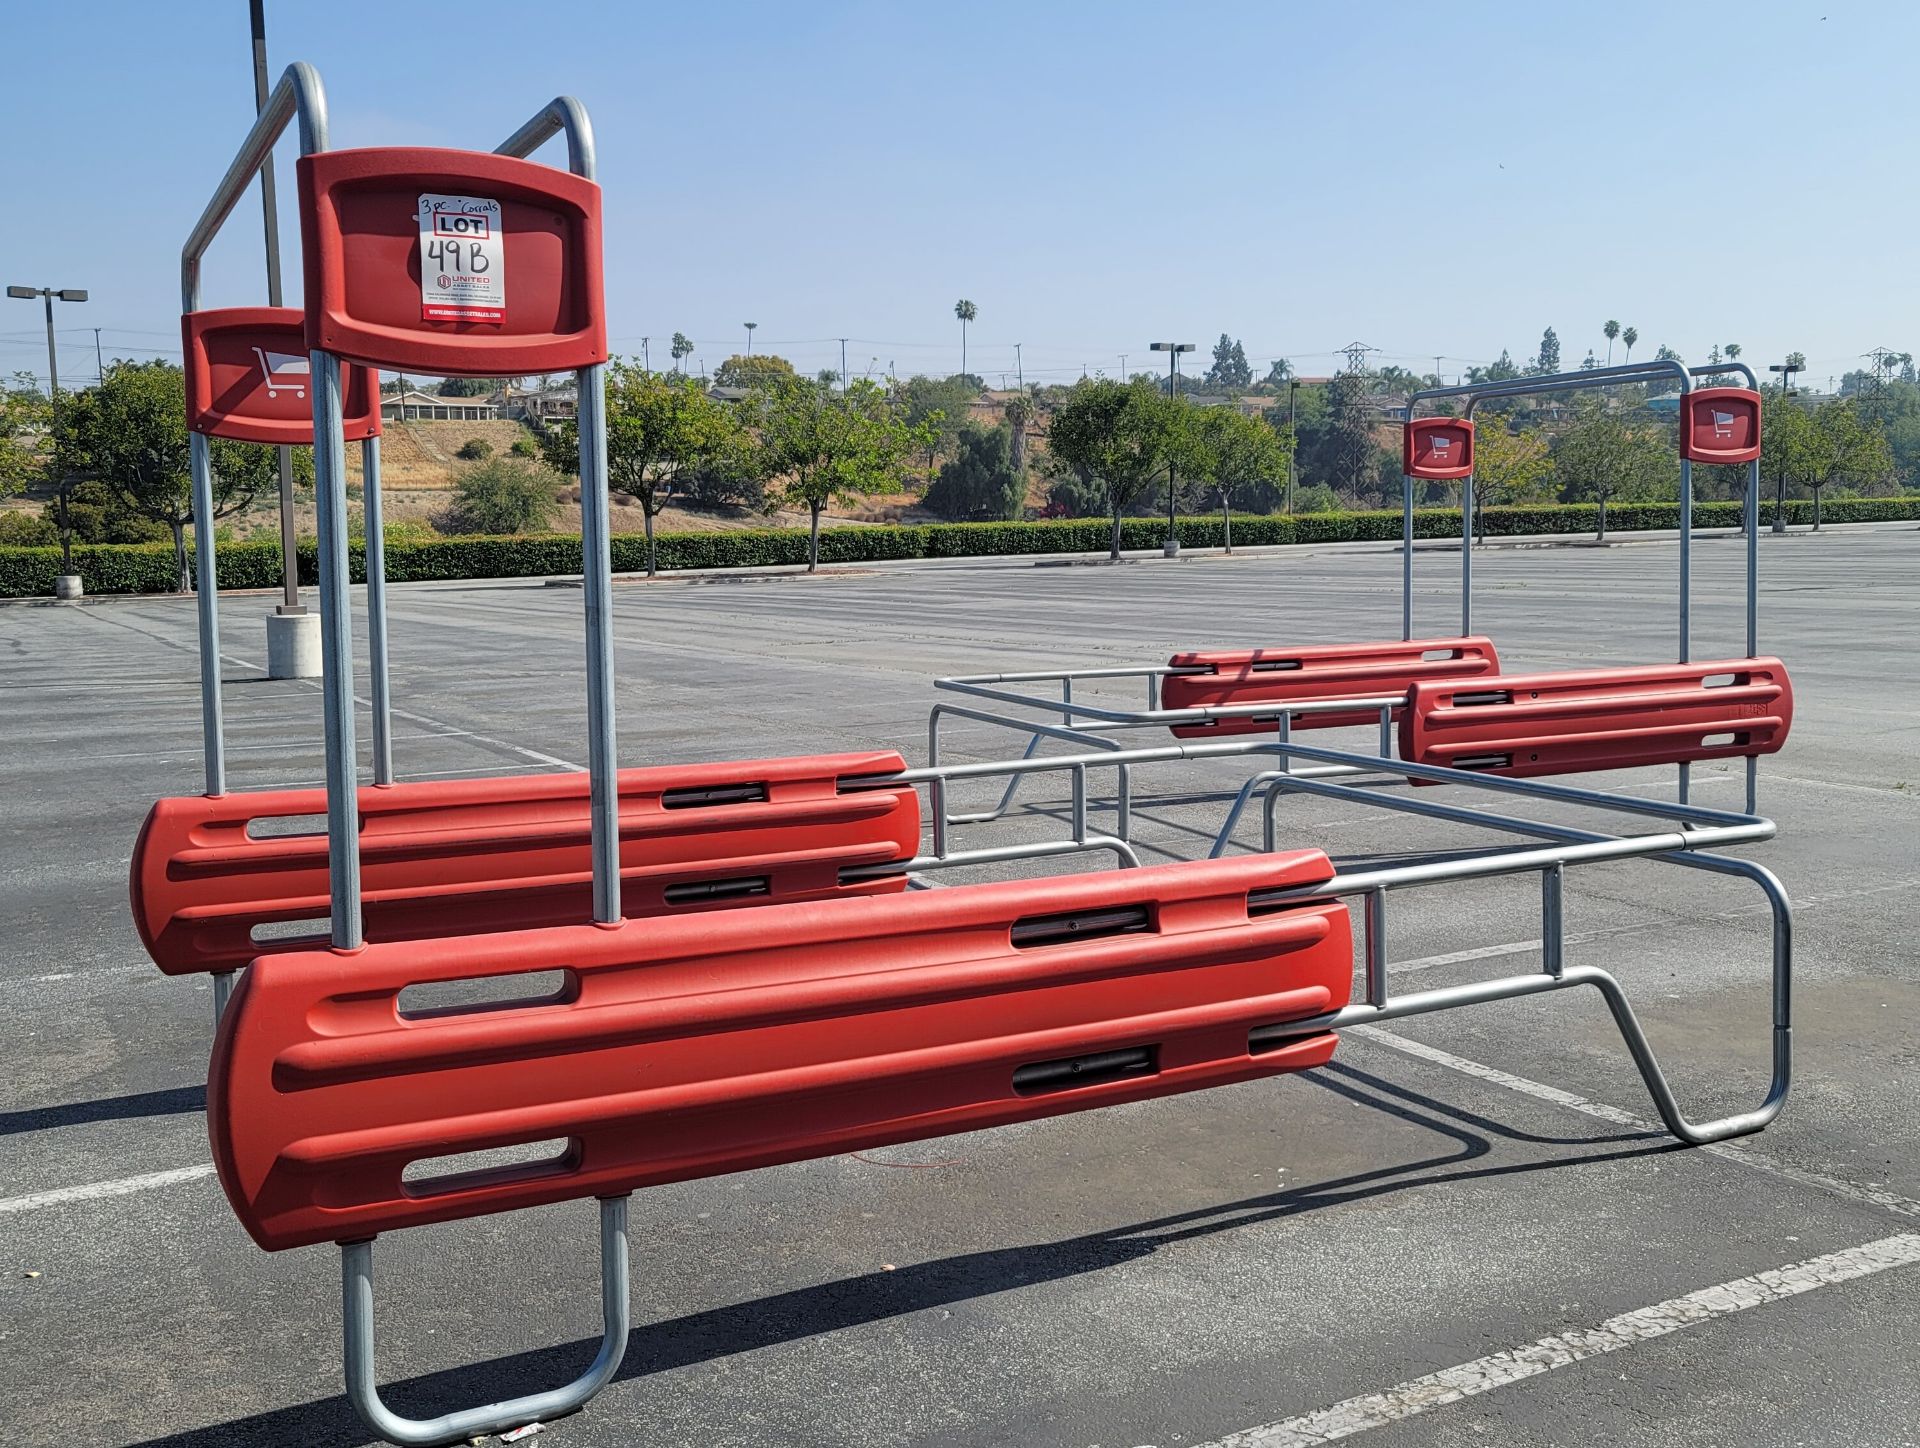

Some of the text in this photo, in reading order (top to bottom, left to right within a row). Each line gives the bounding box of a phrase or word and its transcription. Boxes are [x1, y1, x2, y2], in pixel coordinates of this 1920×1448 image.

[422, 199, 432, 215] 3
[440, 217, 483, 234] LOT
[428, 240, 489, 274] 49 B
